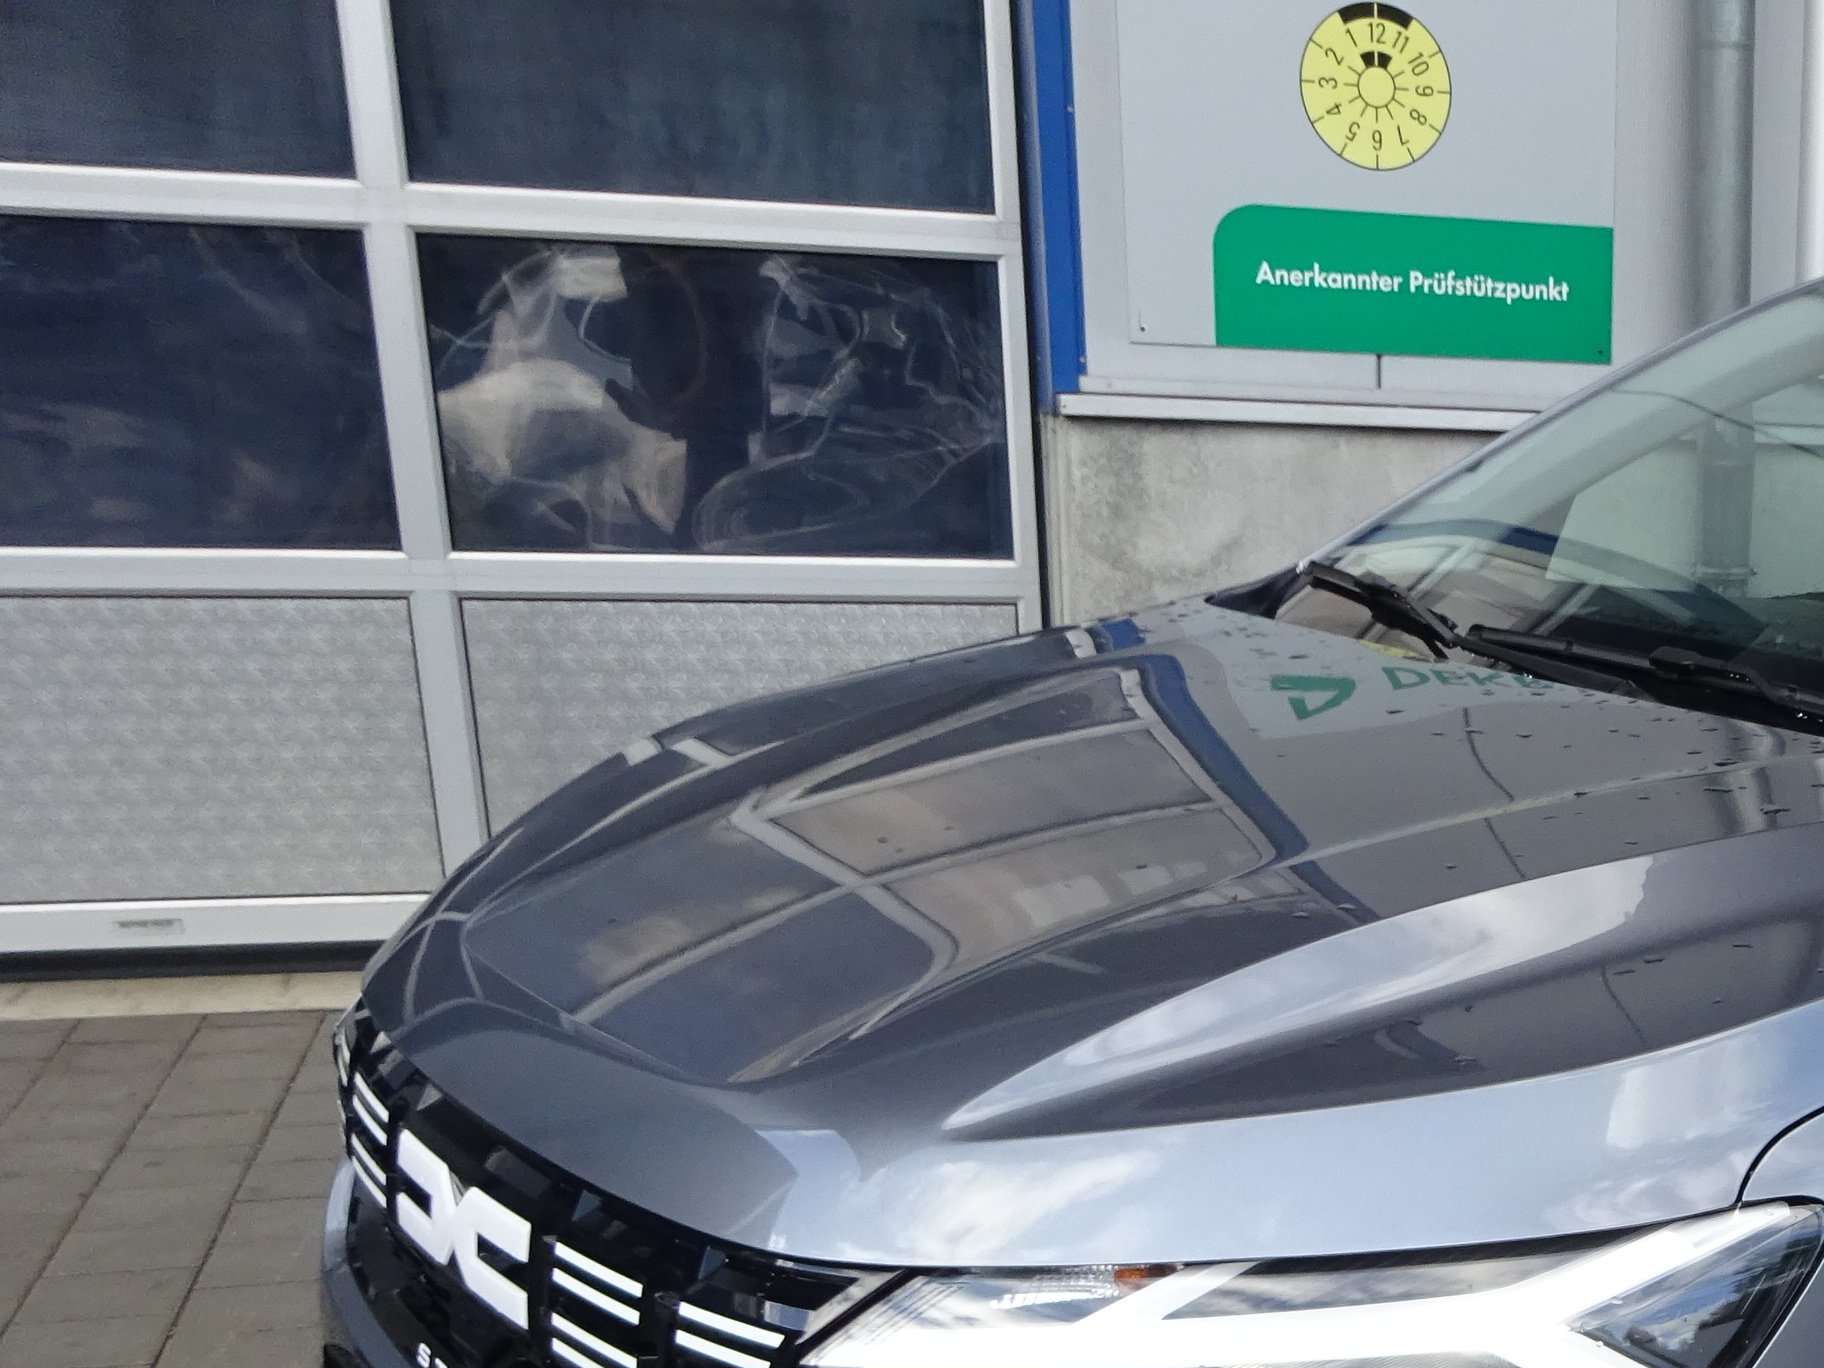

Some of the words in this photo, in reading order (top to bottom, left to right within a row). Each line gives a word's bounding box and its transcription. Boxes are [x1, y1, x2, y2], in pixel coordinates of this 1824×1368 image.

[1345, 28, 1358, 48] 1
[1367, 22, 1387, 45] 12
[1392, 31, 1409, 54] 11
[1325, 47, 1344, 66] 2
[1408, 52, 1430, 77] 10
[1318, 76, 1338, 89] 3
[1326, 103, 1342, 116] 4
[1409, 109, 1427, 126] 8
[1345, 121, 1360, 142] 5
[1397, 125, 1410, 147] 7
[1255, 260, 1403, 293] Anerkannter
[1409, 270, 1570, 305] Prüfstützpunkt
